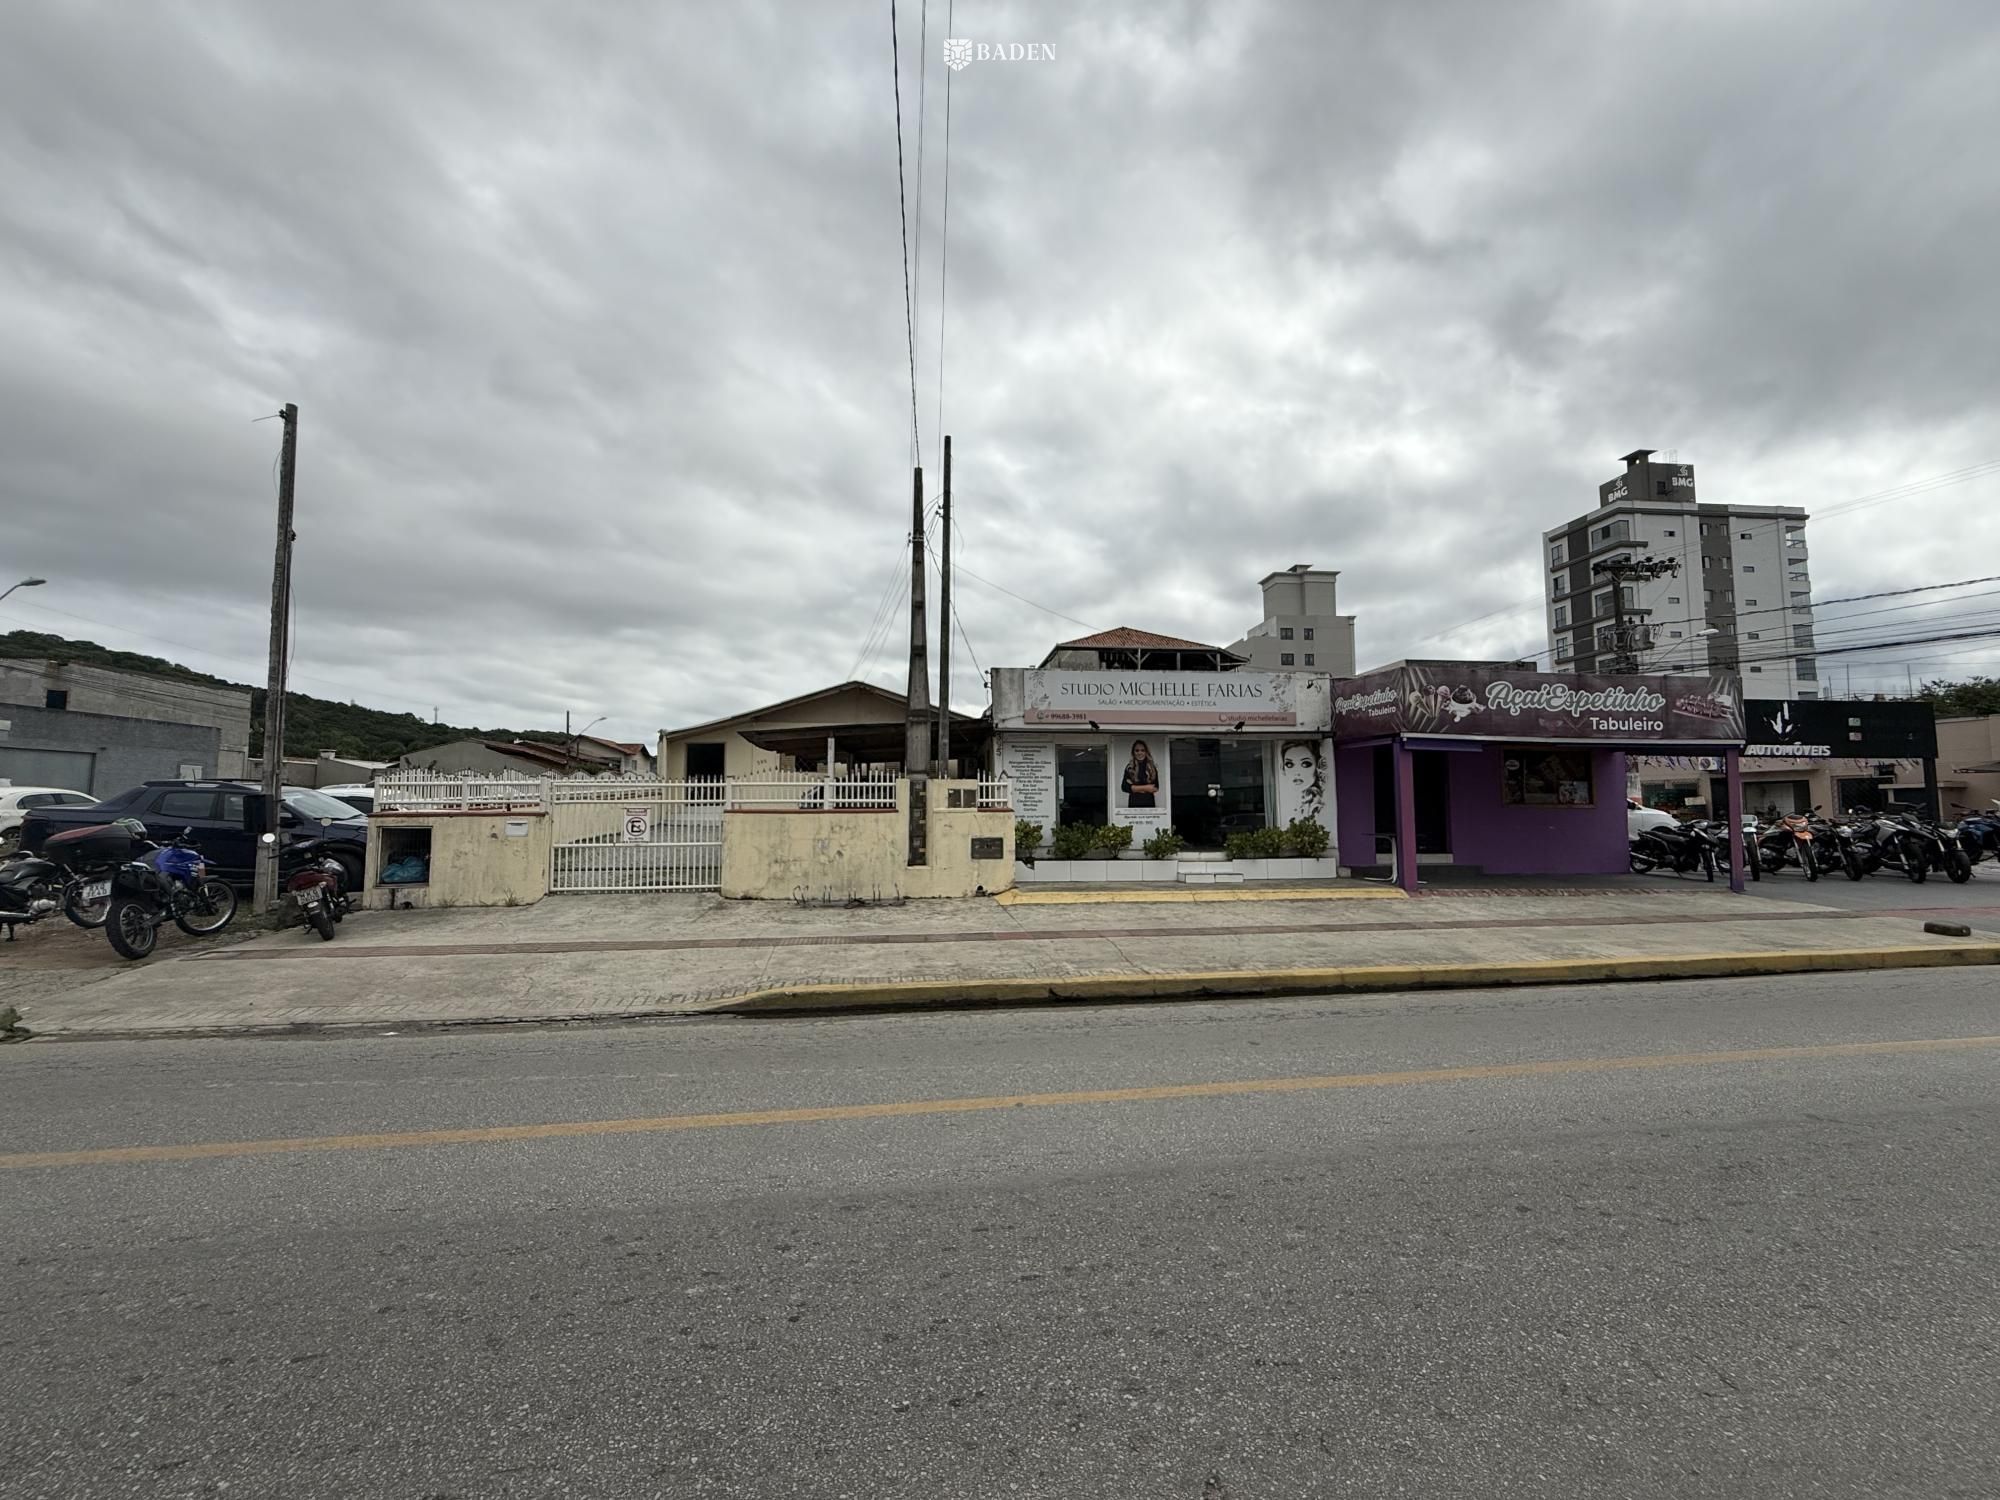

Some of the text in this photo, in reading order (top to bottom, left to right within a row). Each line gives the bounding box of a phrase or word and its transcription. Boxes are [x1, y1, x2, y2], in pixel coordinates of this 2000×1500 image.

[1671, 477, 1693, 487] BMG
[1607, 486, 1628, 502] BMG
[1060, 681, 1263, 698] STUDIO MICHELLE FARIAS
[1368, 705, 1397, 717] Tabuleiro
[1589, 716, 1664, 732] Tabuleiro
[1743, 741, 1831, 756] AUTOMÓVEIS
